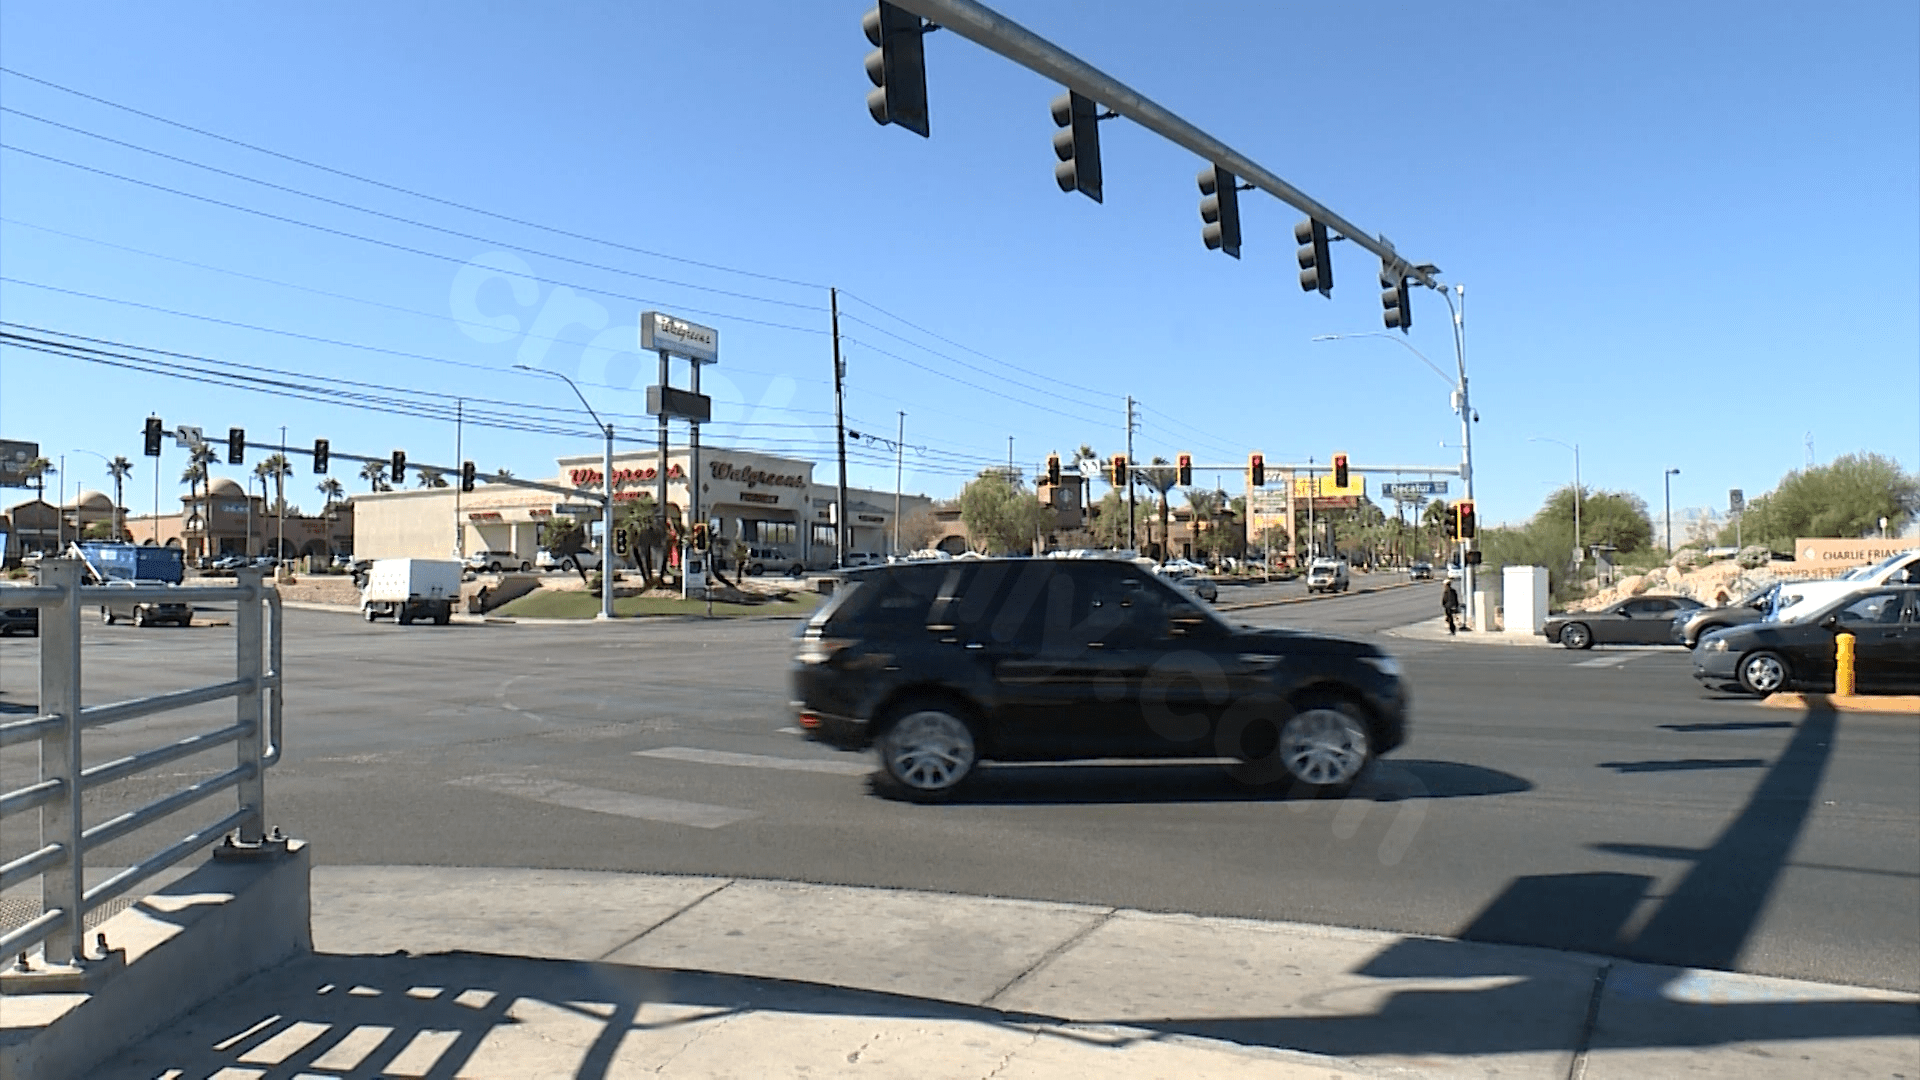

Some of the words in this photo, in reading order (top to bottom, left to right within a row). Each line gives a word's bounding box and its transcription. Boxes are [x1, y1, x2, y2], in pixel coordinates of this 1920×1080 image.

[569, 463, 684, 489] Wagrees
[709, 460, 807, 489] Walgreens
[1391, 483, 1431, 494] Decatur
[1822, 551, 1865, 560] CHARLIE
